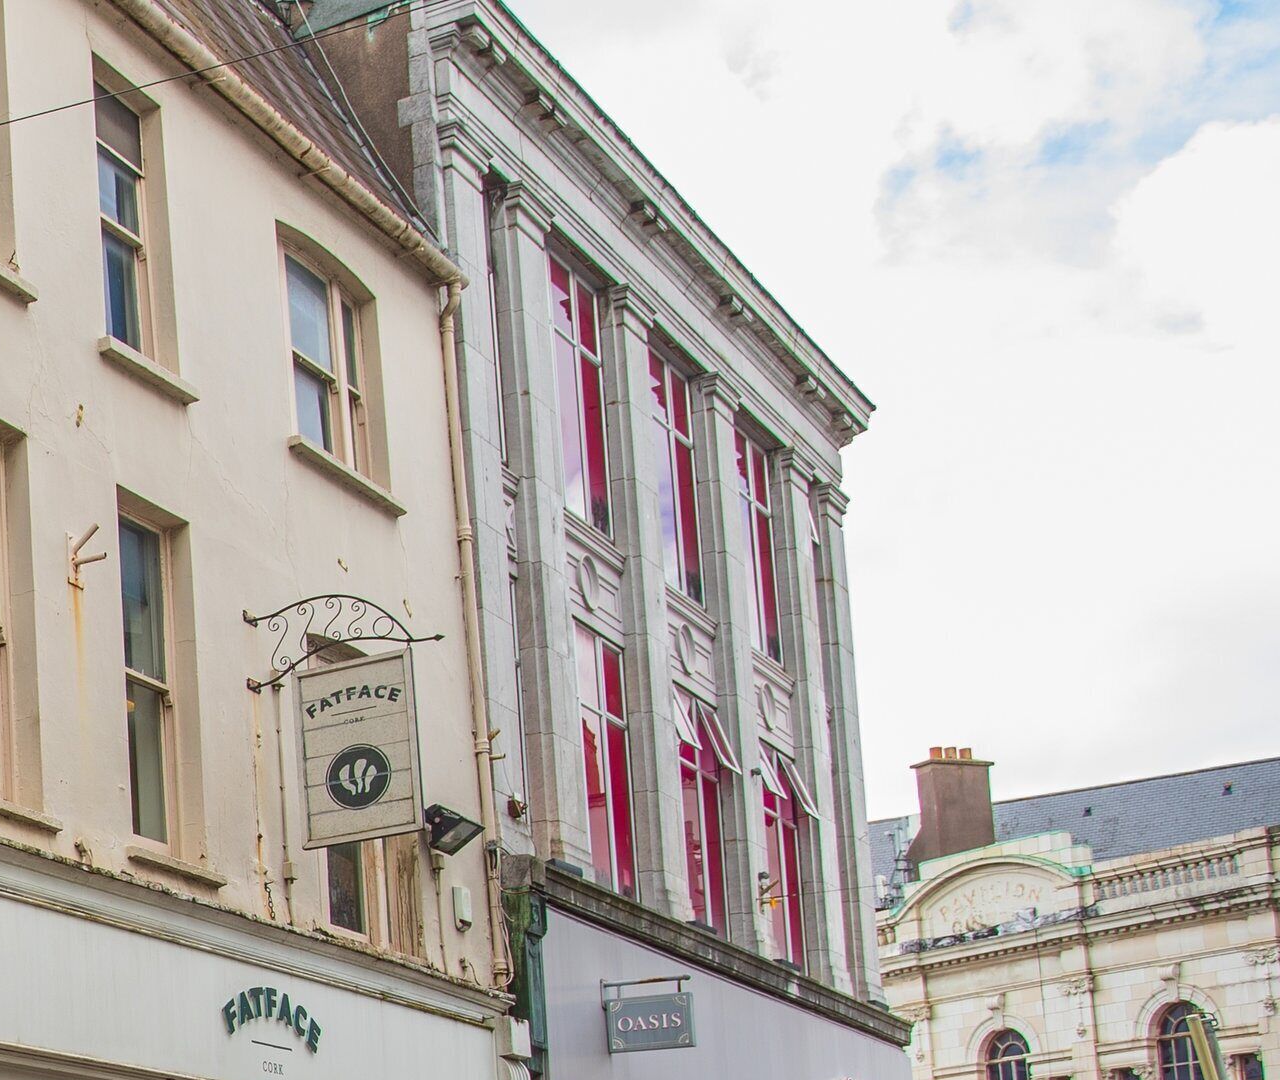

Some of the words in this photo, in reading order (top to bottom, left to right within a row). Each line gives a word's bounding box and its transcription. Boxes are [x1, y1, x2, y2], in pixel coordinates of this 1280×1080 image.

[305, 684, 402, 720] FATFACE
[221, 986, 323, 1054] FATFACE
[617, 1011, 683, 1032] OASIS
[262, 1060, 285, 1076] CORK
